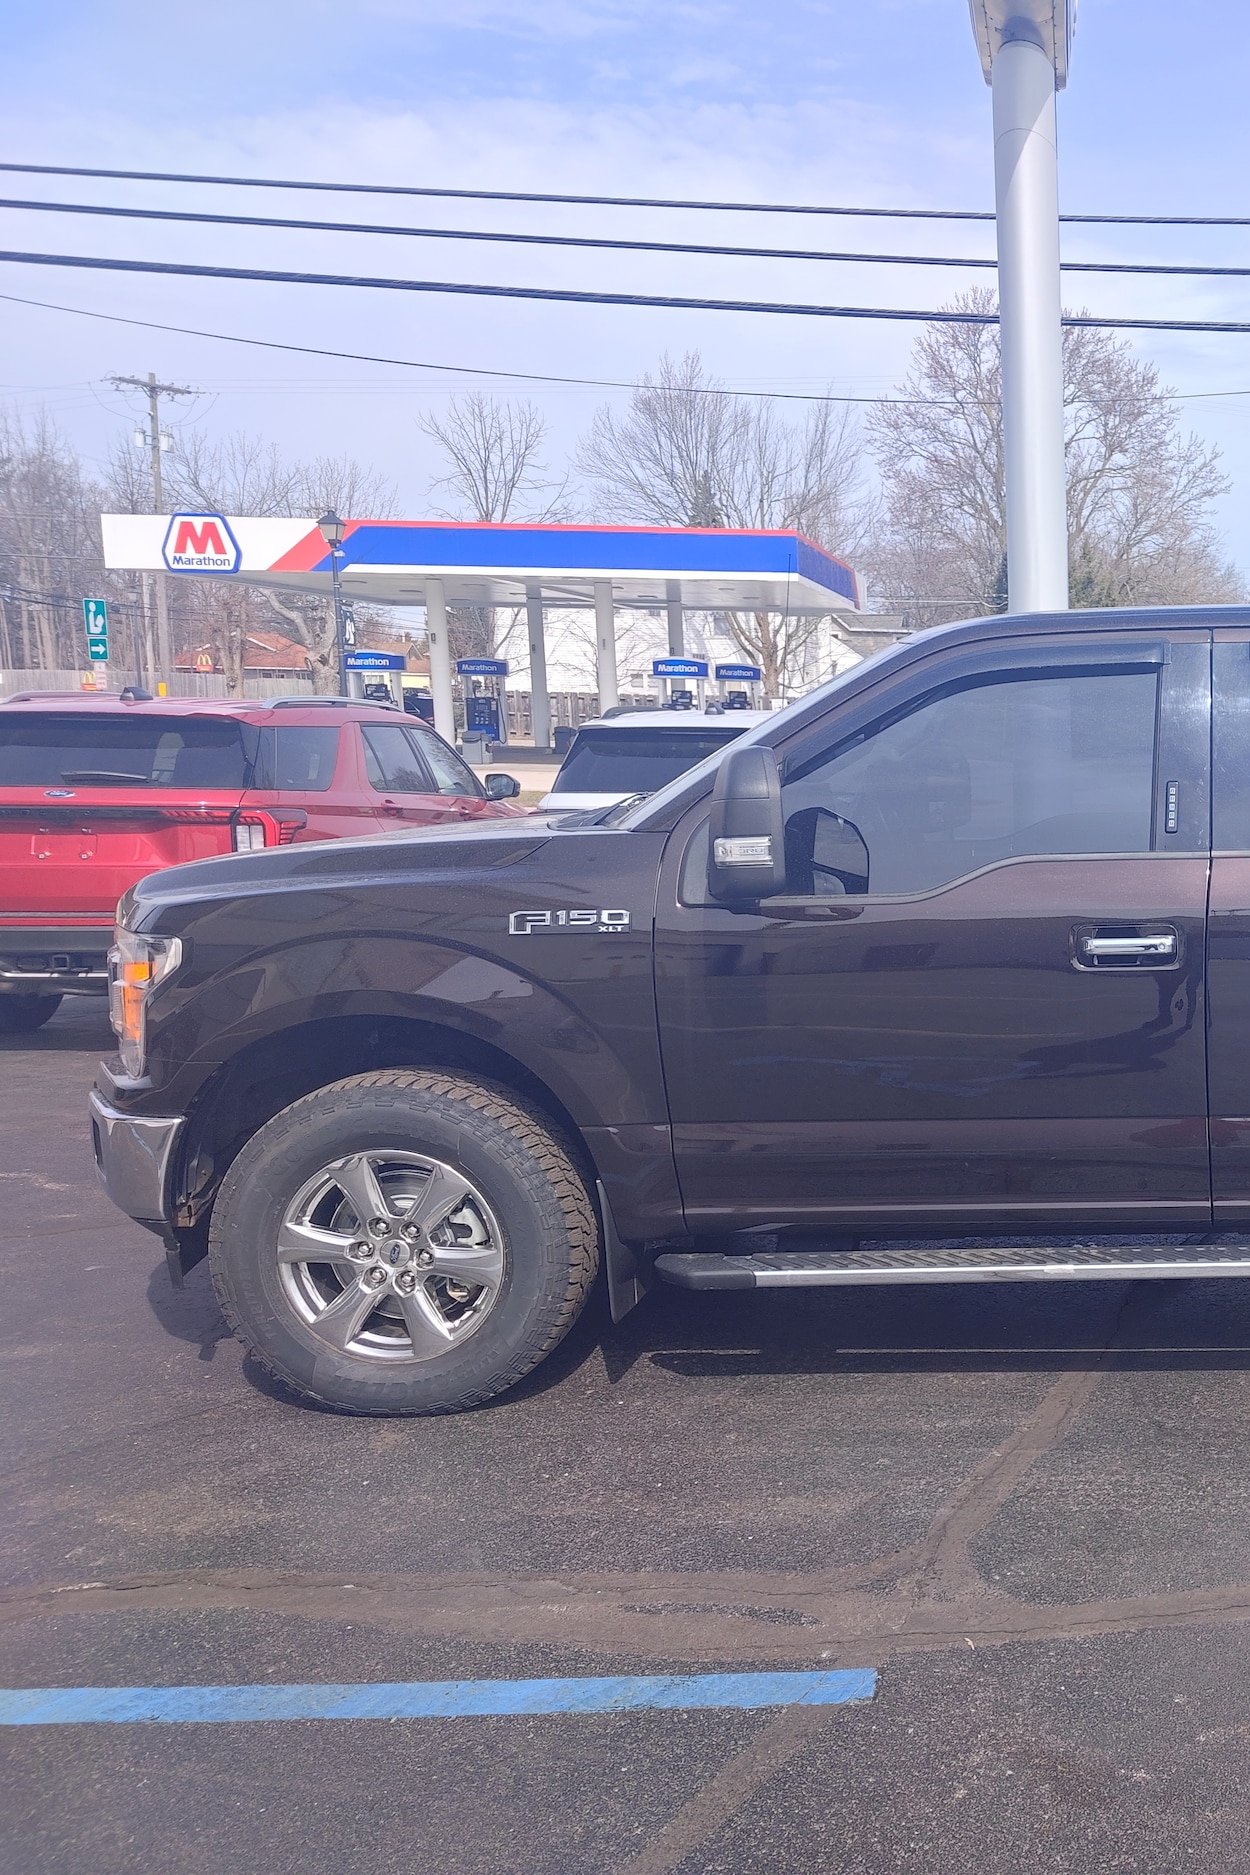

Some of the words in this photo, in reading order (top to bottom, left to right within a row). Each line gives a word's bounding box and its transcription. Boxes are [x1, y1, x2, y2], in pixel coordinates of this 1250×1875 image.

[173, 520, 228, 555] M
[172, 555, 231, 567] Marathon
[346, 657, 390, 667] Marathon
[461, 662, 498, 672] Marathon
[657, 663, 699, 673] Marathon
[719, 668, 754, 677] Marathon
[598, 924, 625, 933] XLT
